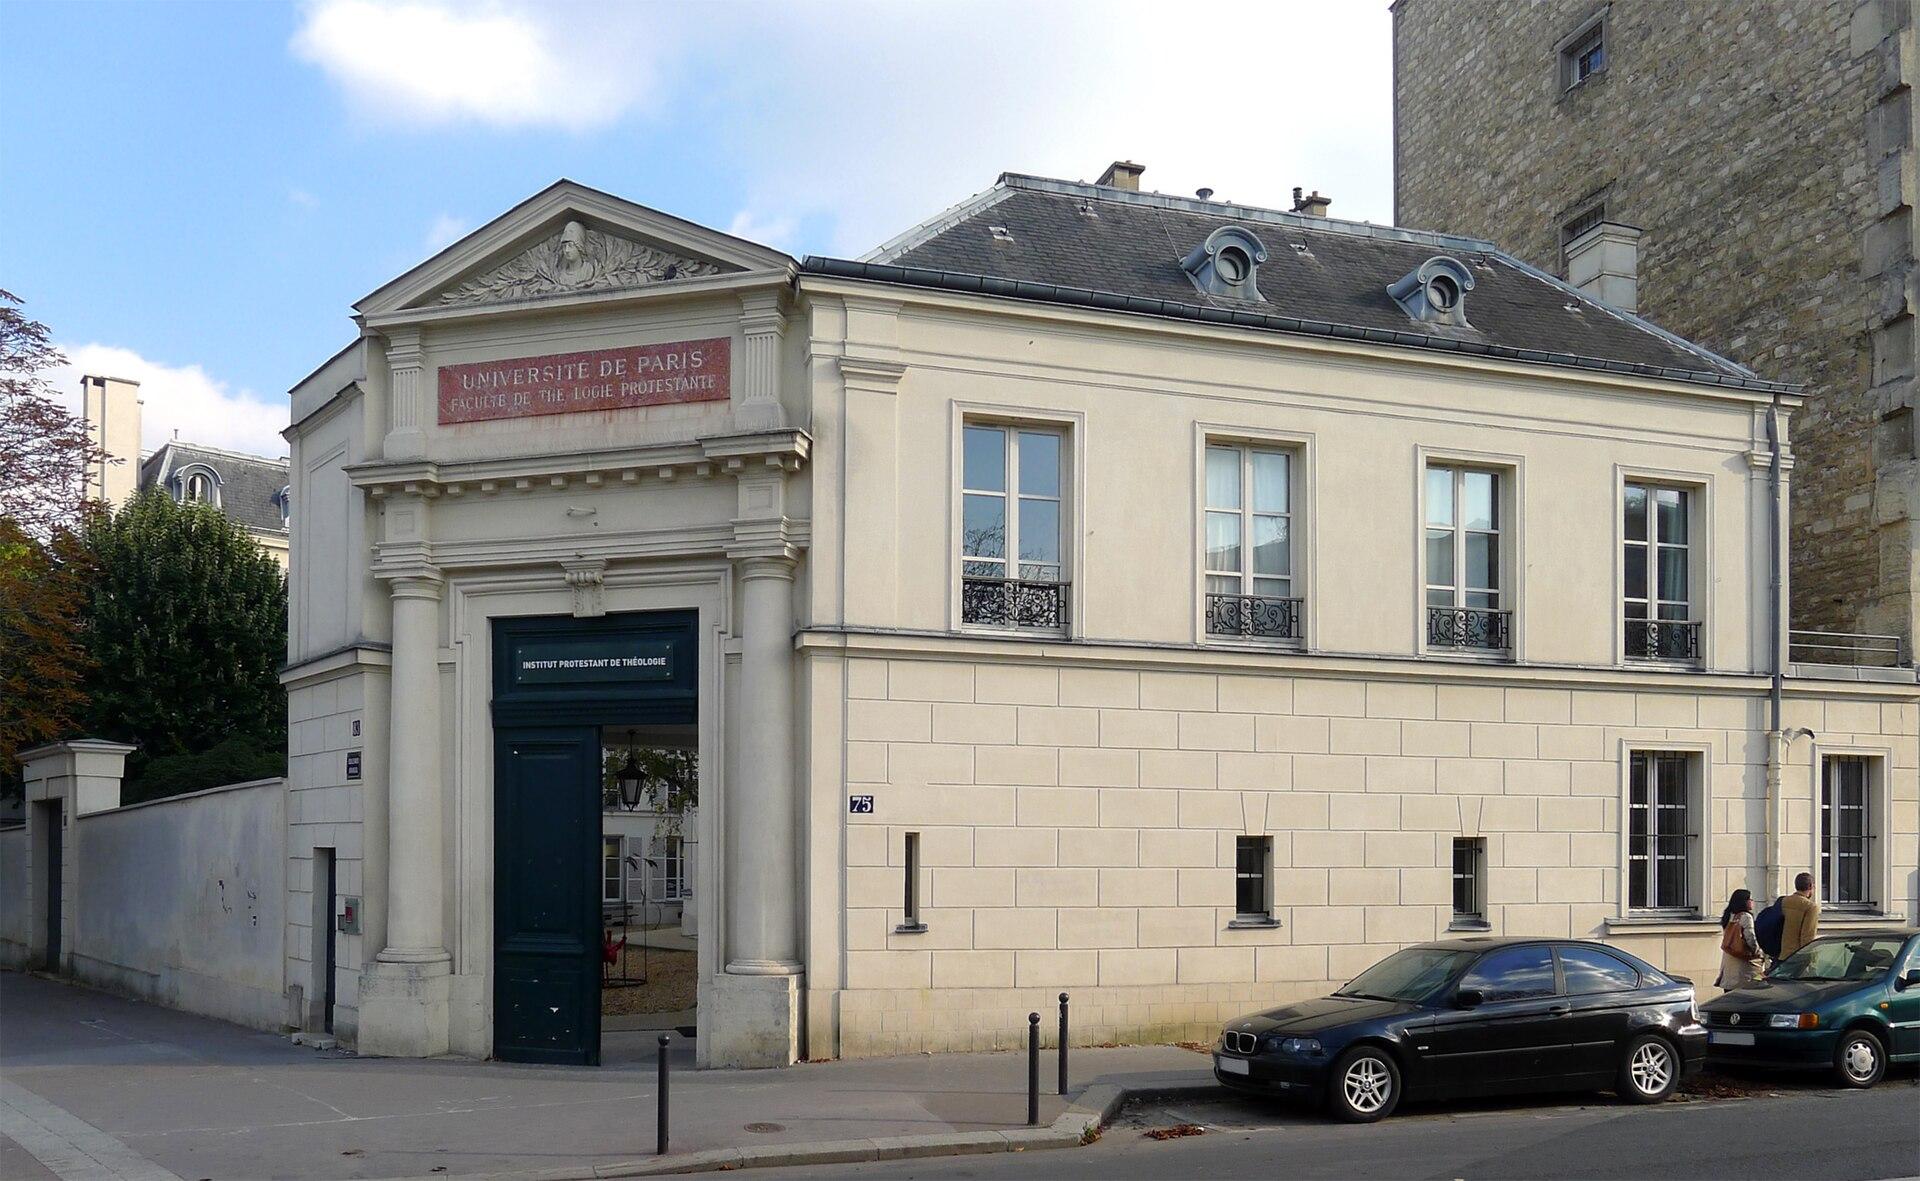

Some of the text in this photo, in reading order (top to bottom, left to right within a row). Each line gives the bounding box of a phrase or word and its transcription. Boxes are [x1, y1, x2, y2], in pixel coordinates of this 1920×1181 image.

[463, 351, 704, 390] UNIVERSITÉ DE PARIS
[514, 391, 531, 406] DE
[621, 374, 716, 397] PROTESTANTE
[522, 656, 667, 669] INSTITUT PROTESTANT DE THÉOLOGIE
[852, 796, 872, 812] 75
